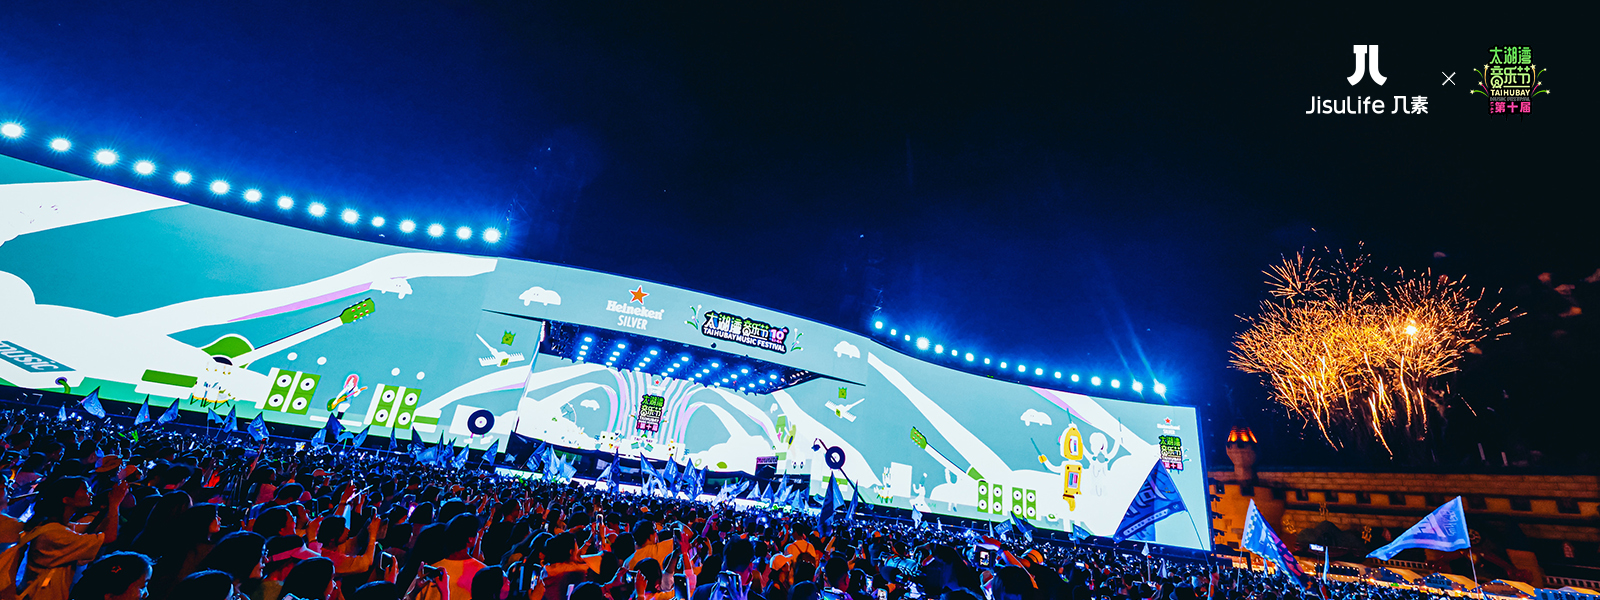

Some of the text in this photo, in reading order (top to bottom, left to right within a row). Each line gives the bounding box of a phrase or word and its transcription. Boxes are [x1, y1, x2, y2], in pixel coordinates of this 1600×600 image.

[606, 300, 665, 320] Heineken
[617, 315, 648, 330] SILVER
[757, 340, 786, 352] FESTIVAL
